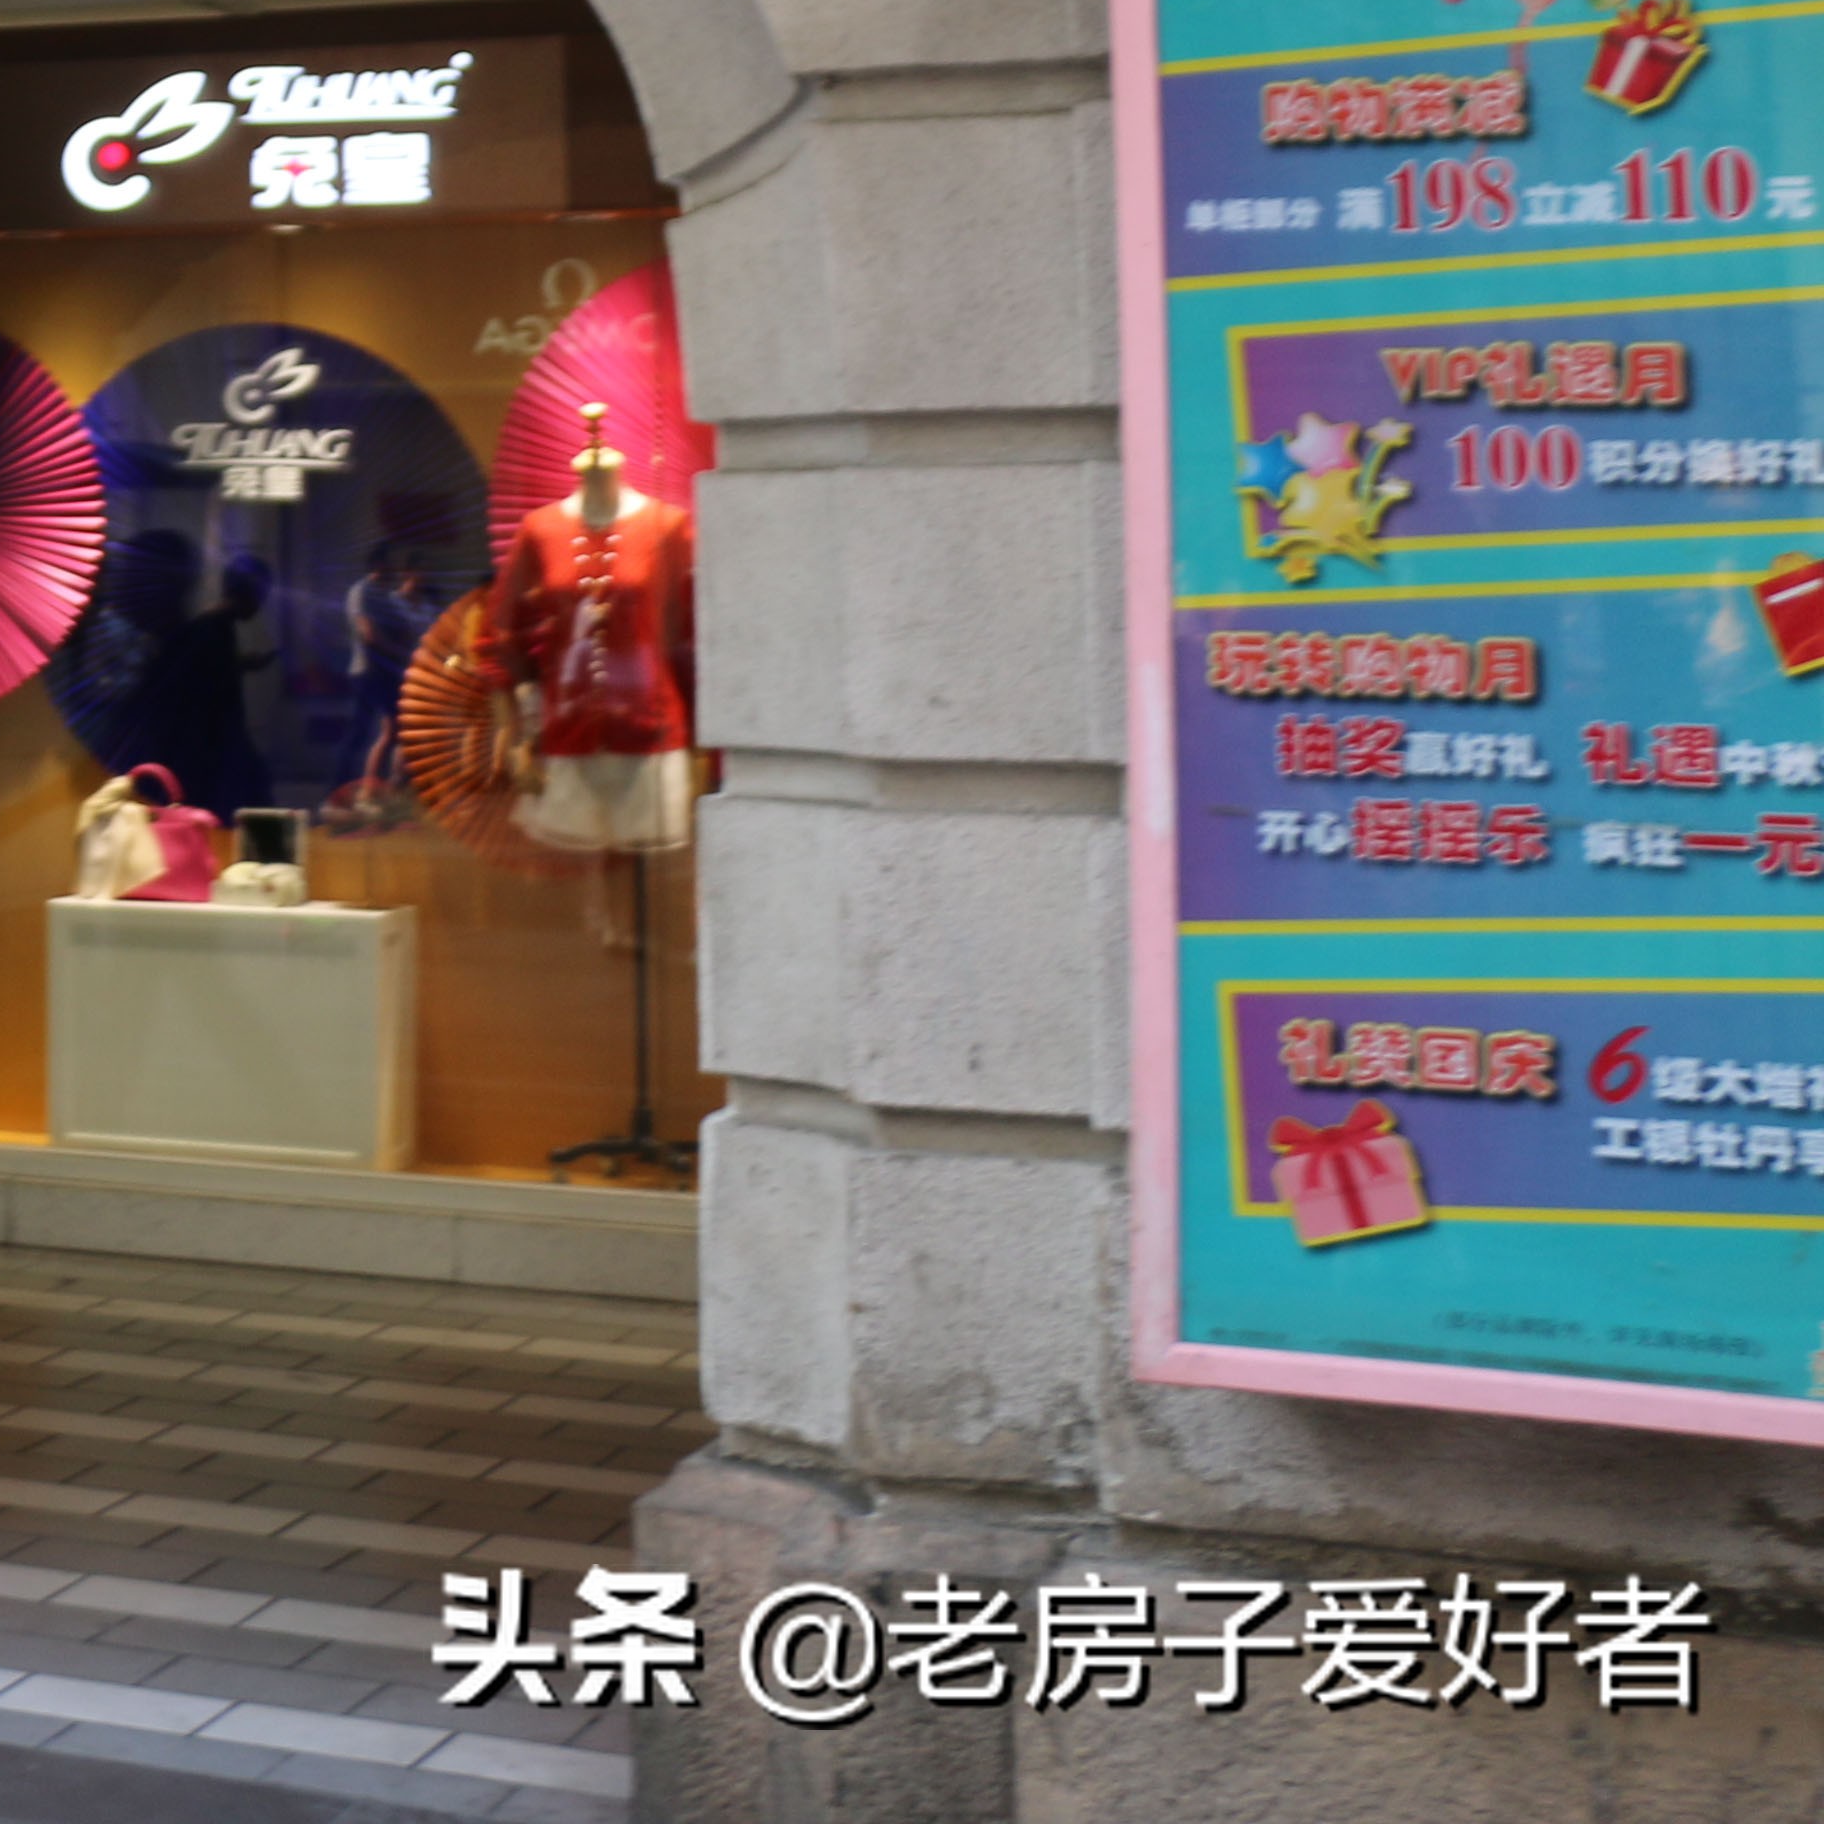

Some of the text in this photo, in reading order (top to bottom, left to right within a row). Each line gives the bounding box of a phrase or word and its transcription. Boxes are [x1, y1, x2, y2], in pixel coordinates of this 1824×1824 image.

[1260, 70, 1529, 143] 购物满减
[1378, 339, 1688, 408] VIP礼遇月
[1206, 630, 1539, 701] 玩转购物月
[1255, 795, 1551, 866] 开心摇摇乐
[1279, 1018, 1559, 1098] 礼赞国庆
